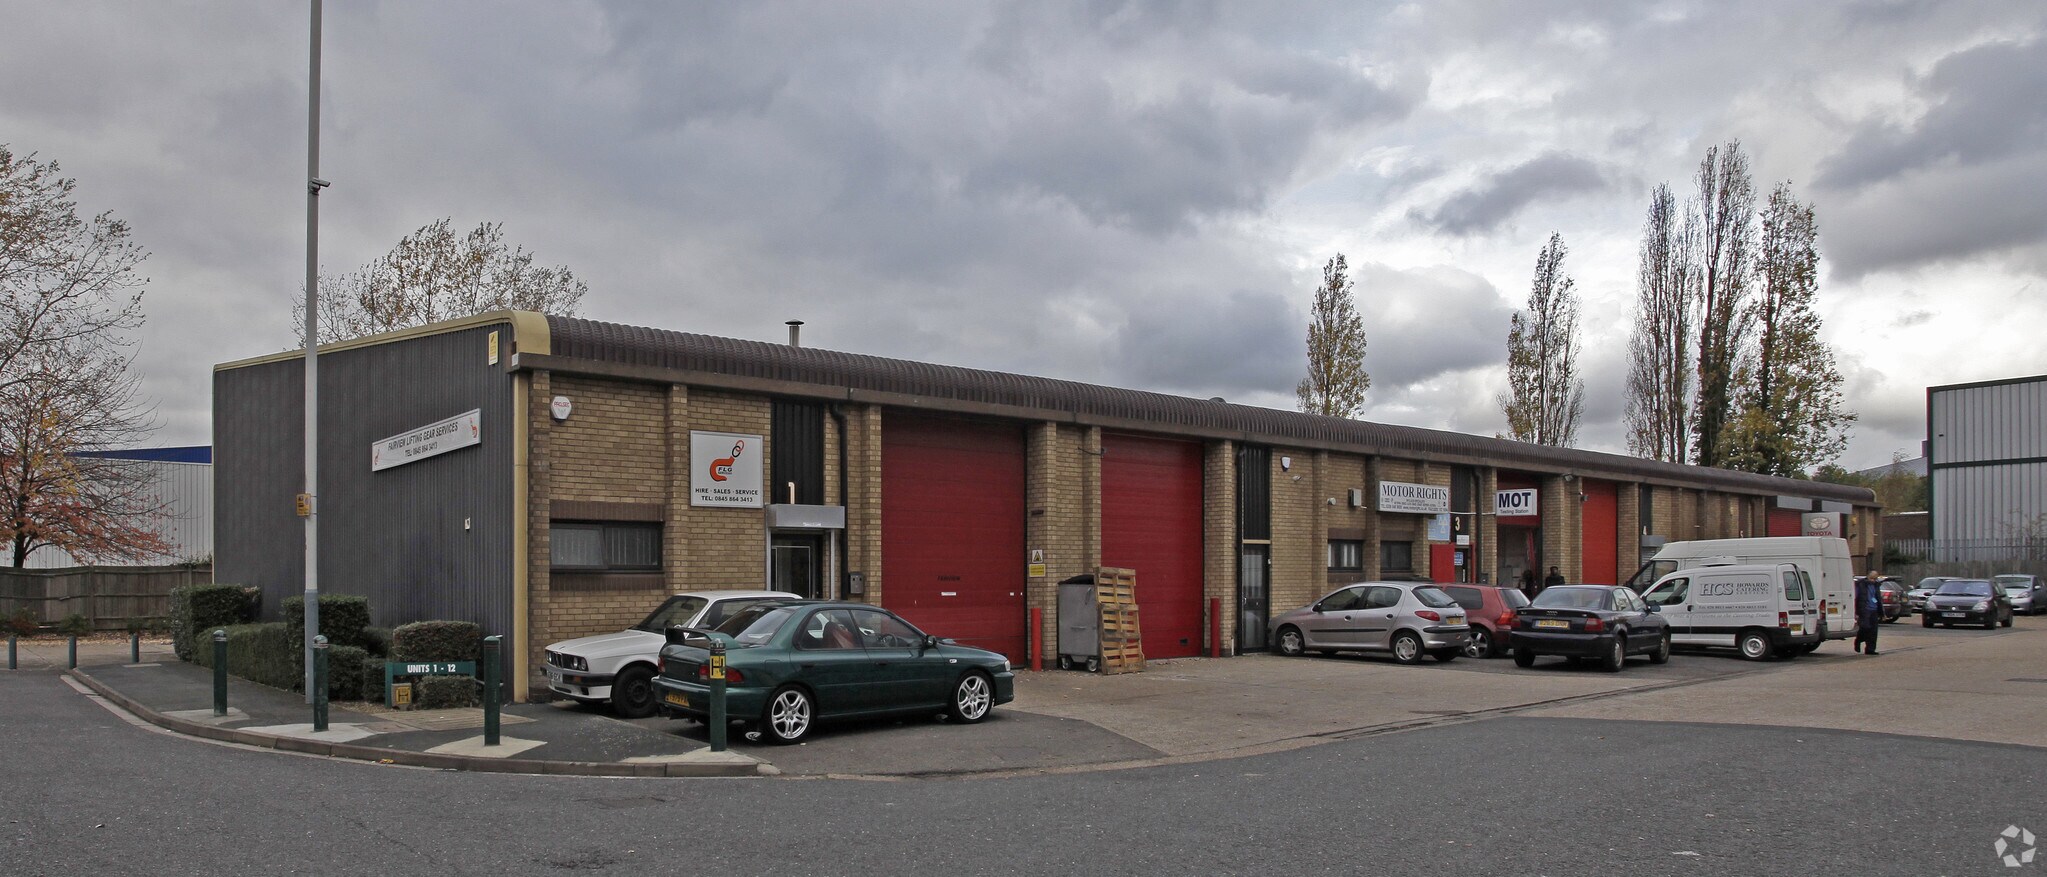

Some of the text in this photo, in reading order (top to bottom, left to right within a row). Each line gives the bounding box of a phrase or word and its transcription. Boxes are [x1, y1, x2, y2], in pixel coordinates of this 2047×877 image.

[388, 421, 459, 451] FAIRVIEW LIFTING GEAR SERVICES
[788, 481, 795, 504] 1
[1382, 484, 1447, 500] MOTOR RIGHTS
[1498, 491, 1532, 508] MOT
[1454, 516, 1460, 531] 3
[1699, 583, 1734, 596] HCS
[407, 664, 430, 673] UNITS
[433, 664, 437, 673] 1
[447, 663, 456, 673] 12
